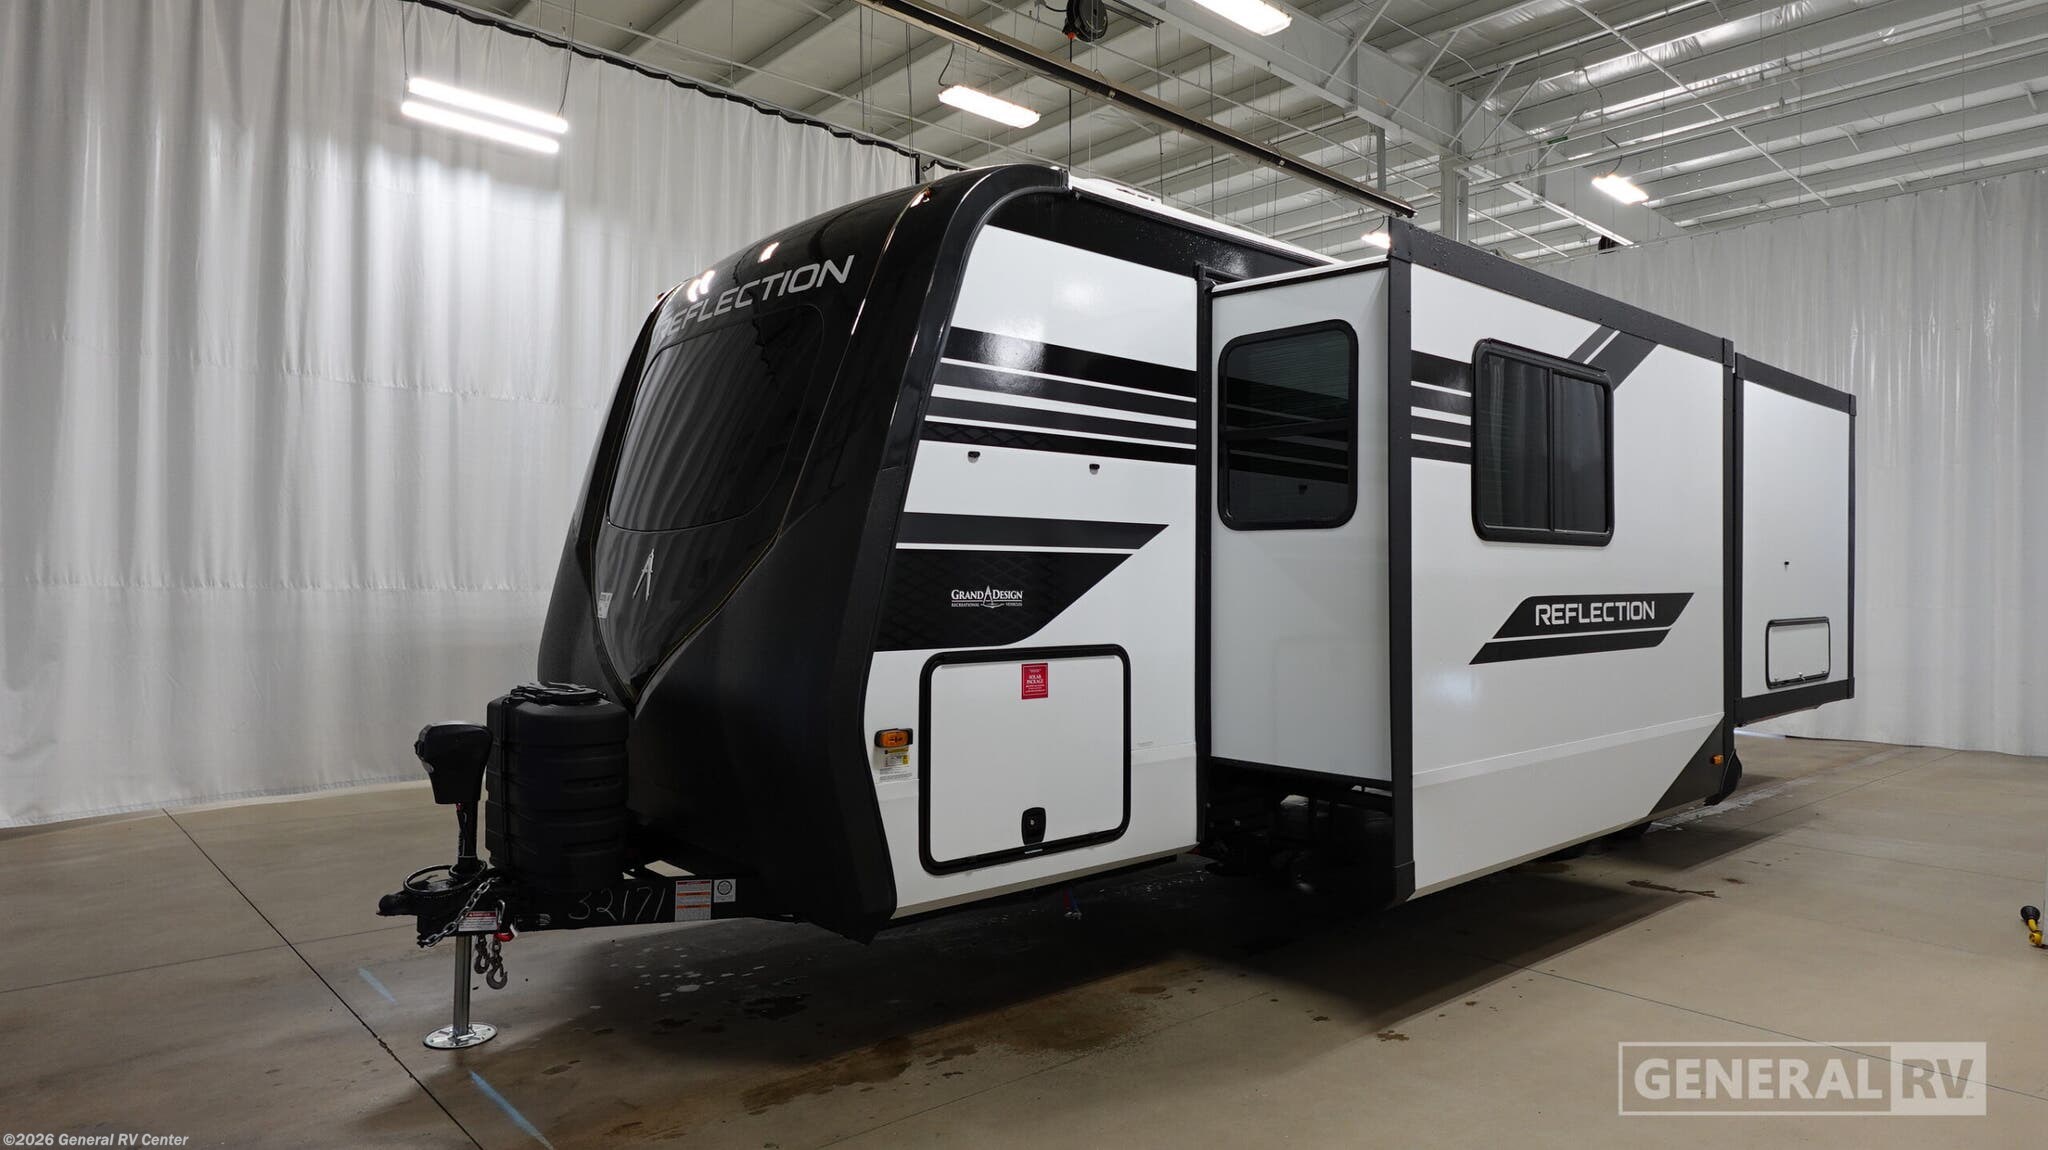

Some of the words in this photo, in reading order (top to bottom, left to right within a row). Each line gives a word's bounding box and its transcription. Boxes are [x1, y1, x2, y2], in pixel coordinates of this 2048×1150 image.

[951, 589, 984, 600] GRAND
[992, 589, 1023, 600] DESIGN
[1535, 601, 1655, 626] REFLECTION
